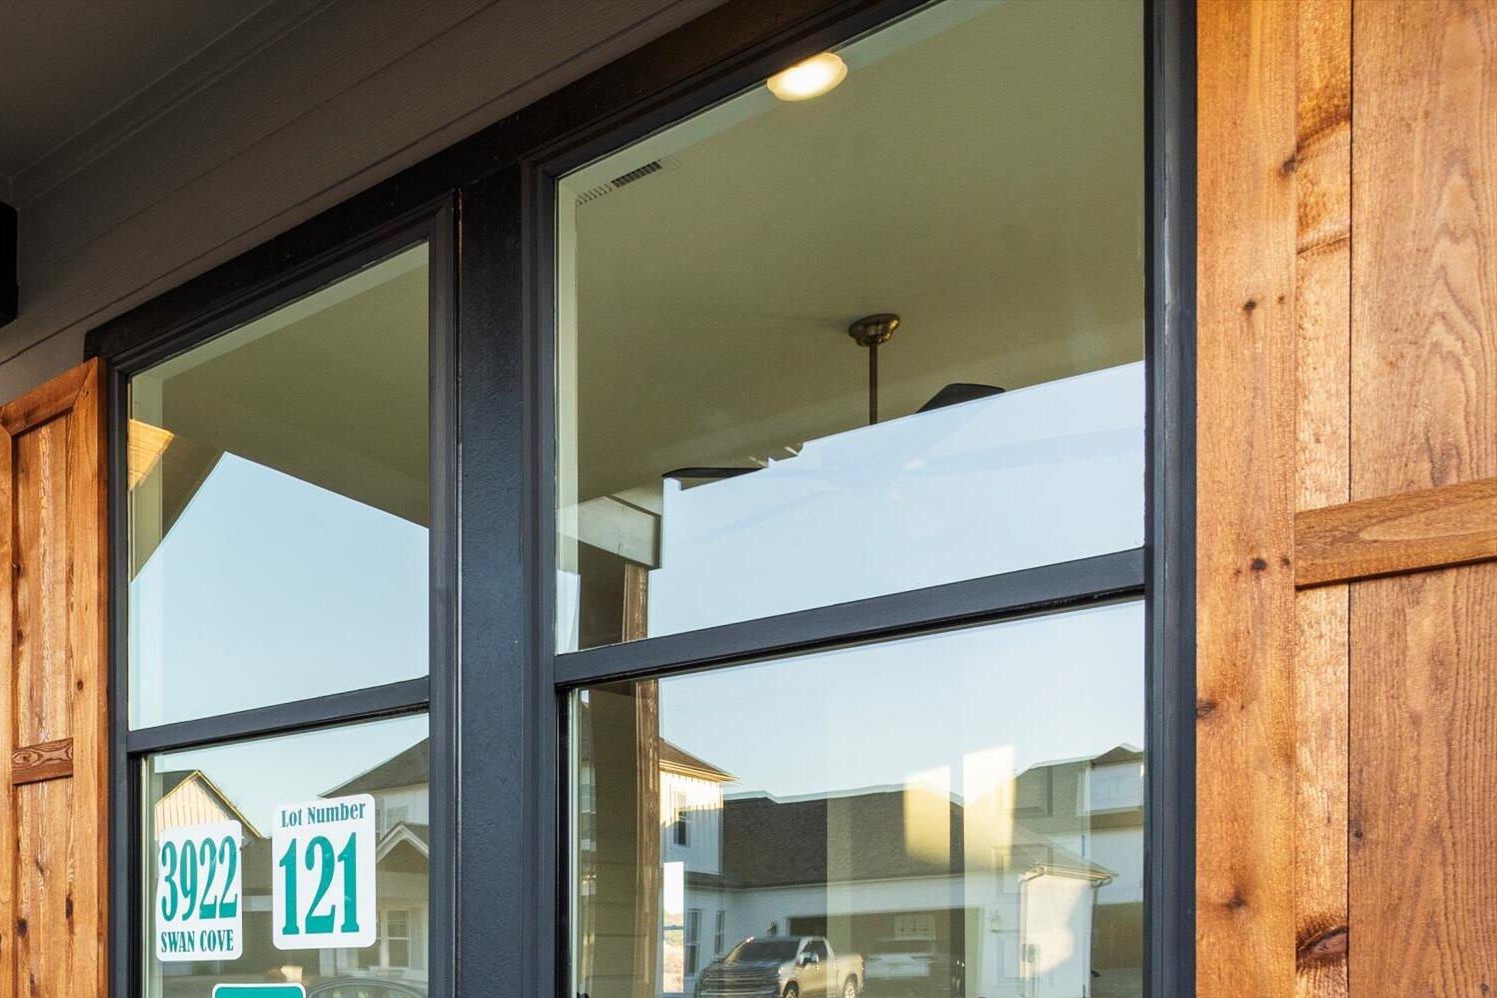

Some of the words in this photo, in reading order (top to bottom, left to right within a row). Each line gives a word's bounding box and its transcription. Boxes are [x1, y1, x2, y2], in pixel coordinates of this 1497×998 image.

[281, 808, 303, 828] Lot
[307, 802, 366, 825] Number
[161, 835, 238, 922] 3922
[279, 832, 360, 936] 121
[161, 930, 195, 953] SWAN
[199, 929, 234, 952] COVE
